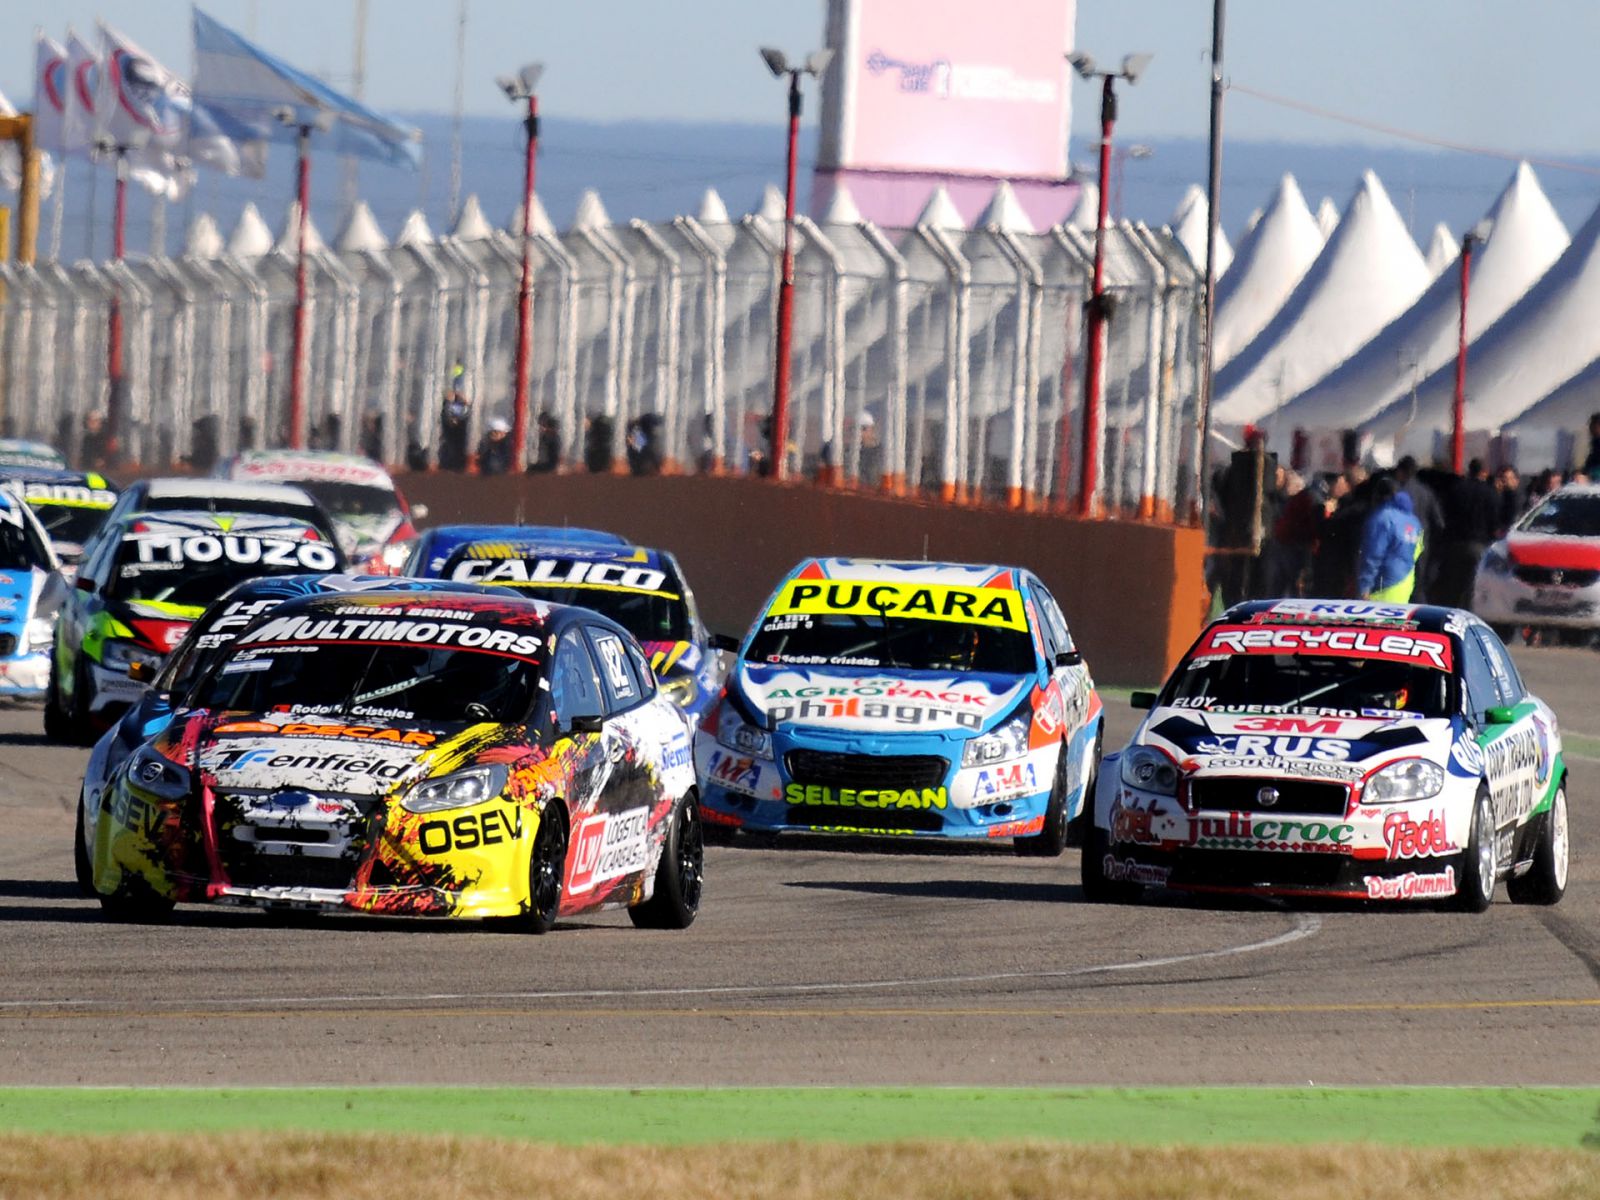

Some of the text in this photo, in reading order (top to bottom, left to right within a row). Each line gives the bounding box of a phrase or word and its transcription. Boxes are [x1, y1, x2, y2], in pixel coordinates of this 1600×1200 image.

[451, 559, 666, 590] CALICO
[335, 606, 476, 621] FUERZA BRIANI
[789, 585, 1013, 622] PUCARA
[1311, 604, 1406, 617] RUS
[236, 616, 542, 654] MULTIMOTORS
[1210, 630, 1447, 668] RECYCLER
[766, 685, 988, 706] AGROPACK
[1171, 696, 1217, 709] ELOY
[767, 698, 983, 732] philagro
[1233, 718, 1343, 734] 3M
[280, 723, 436, 746] DECAR
[1235, 736, 1352, 762] RUS
[786, 783, 947, 809] SELECPAN
[419, 805, 522, 855] OSEV
